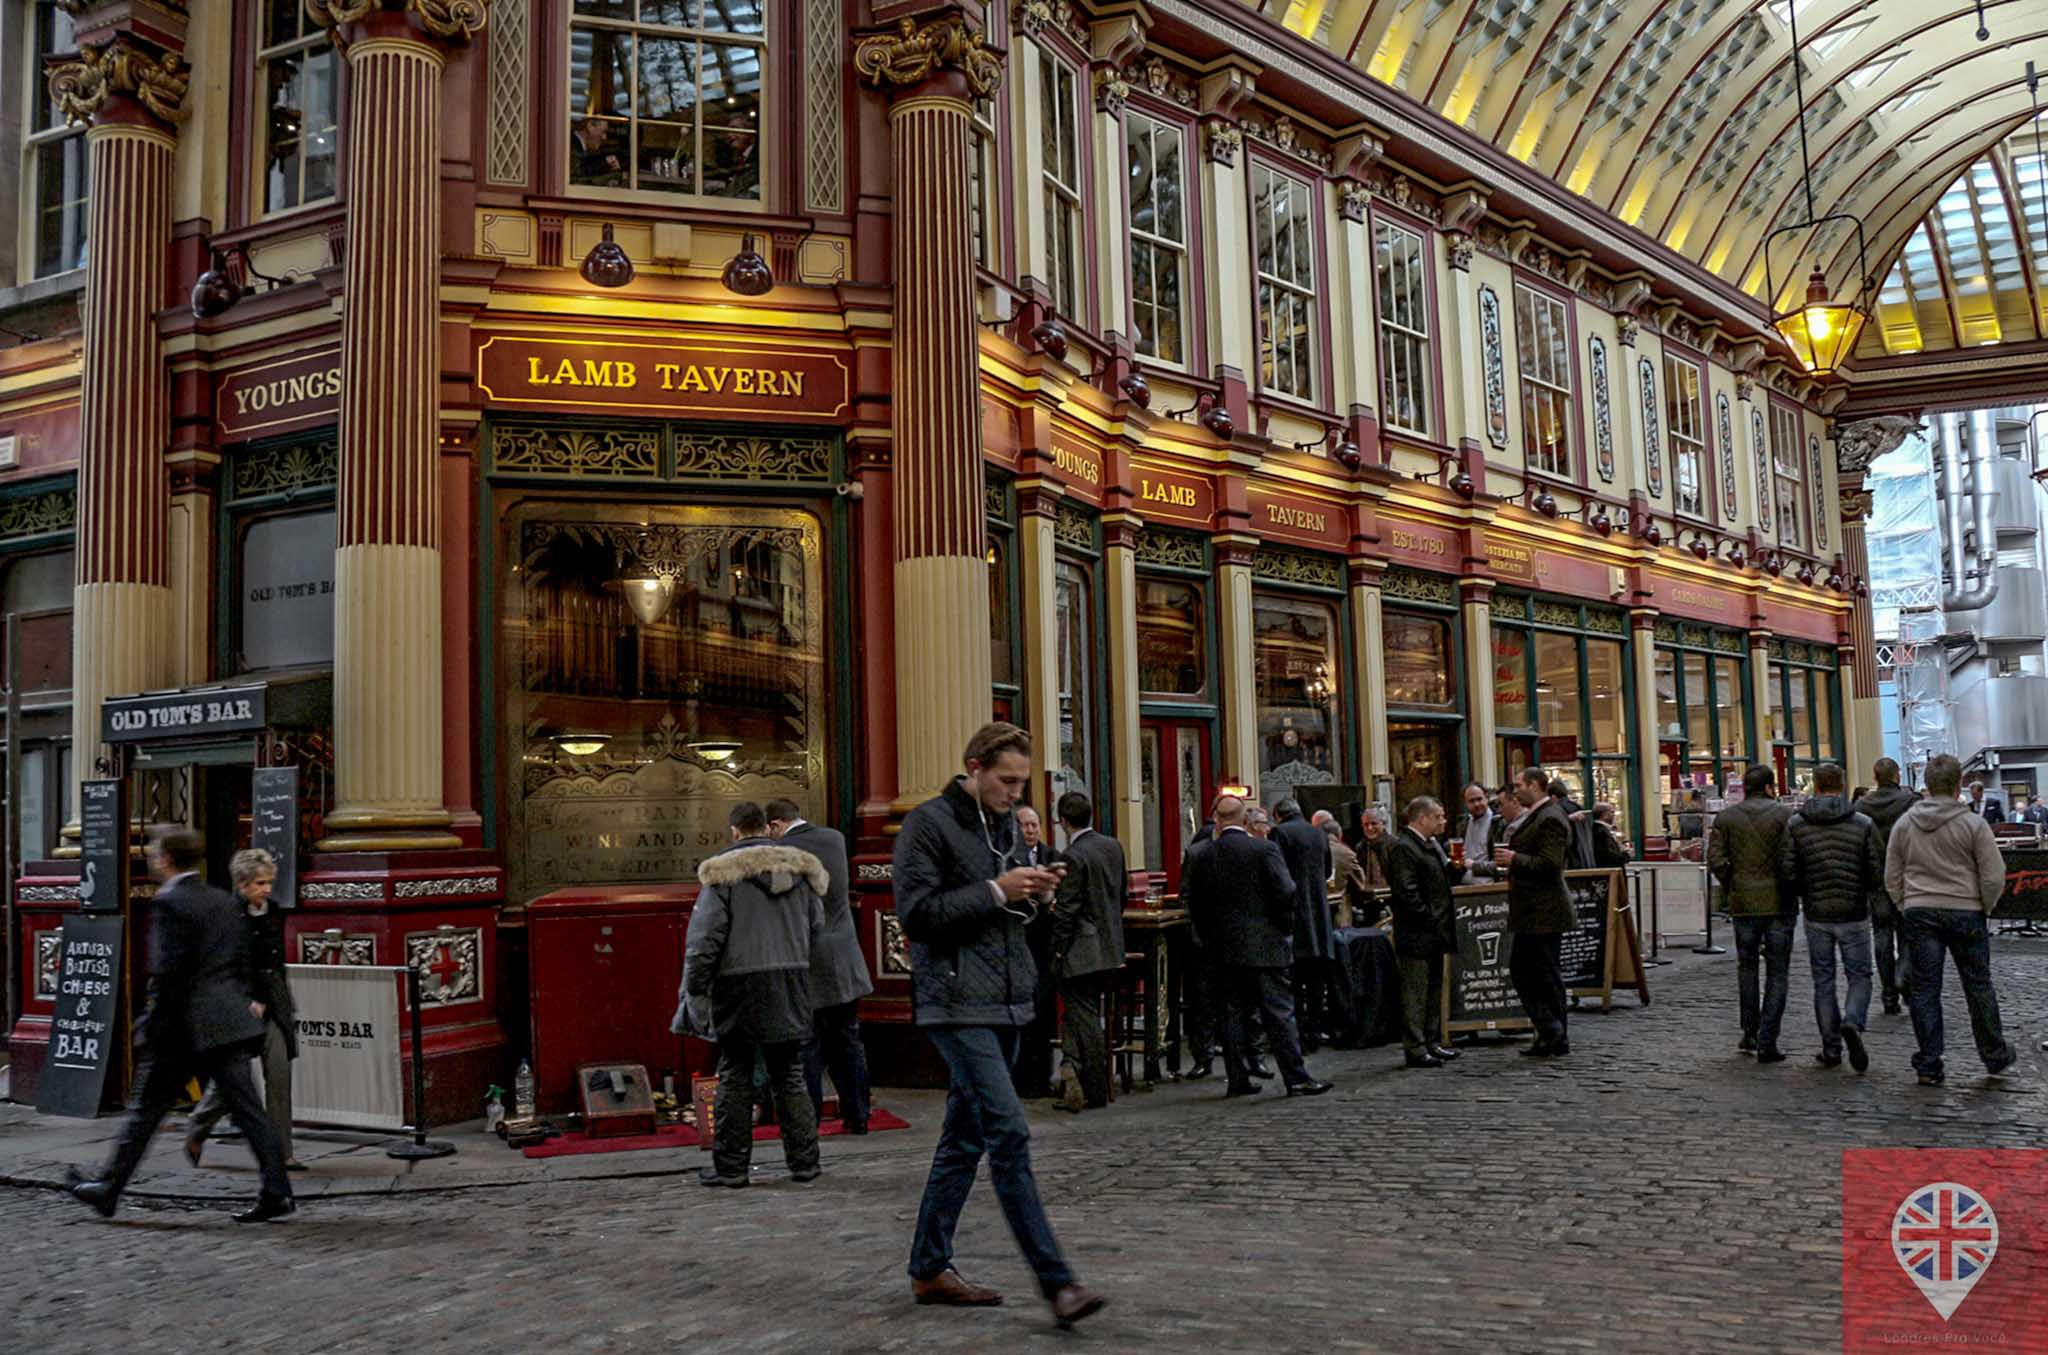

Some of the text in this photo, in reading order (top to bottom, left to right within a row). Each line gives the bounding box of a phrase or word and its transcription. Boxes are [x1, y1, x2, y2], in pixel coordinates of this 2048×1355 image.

[234, 368, 341, 414] YOUNGS
[528, 357, 805, 397] LAMB TAVERN
[1141, 479, 1196, 507] LAMB
[1266, 503, 1325, 532] TAVERN
[111, 700, 252, 731] OLD TOM'S BAR
[635, 832, 685, 847] AND
[76, 997, 91, 1016] &
[339, 1022, 374, 1038] BAR
[54, 1033, 99, 1060] BAR
